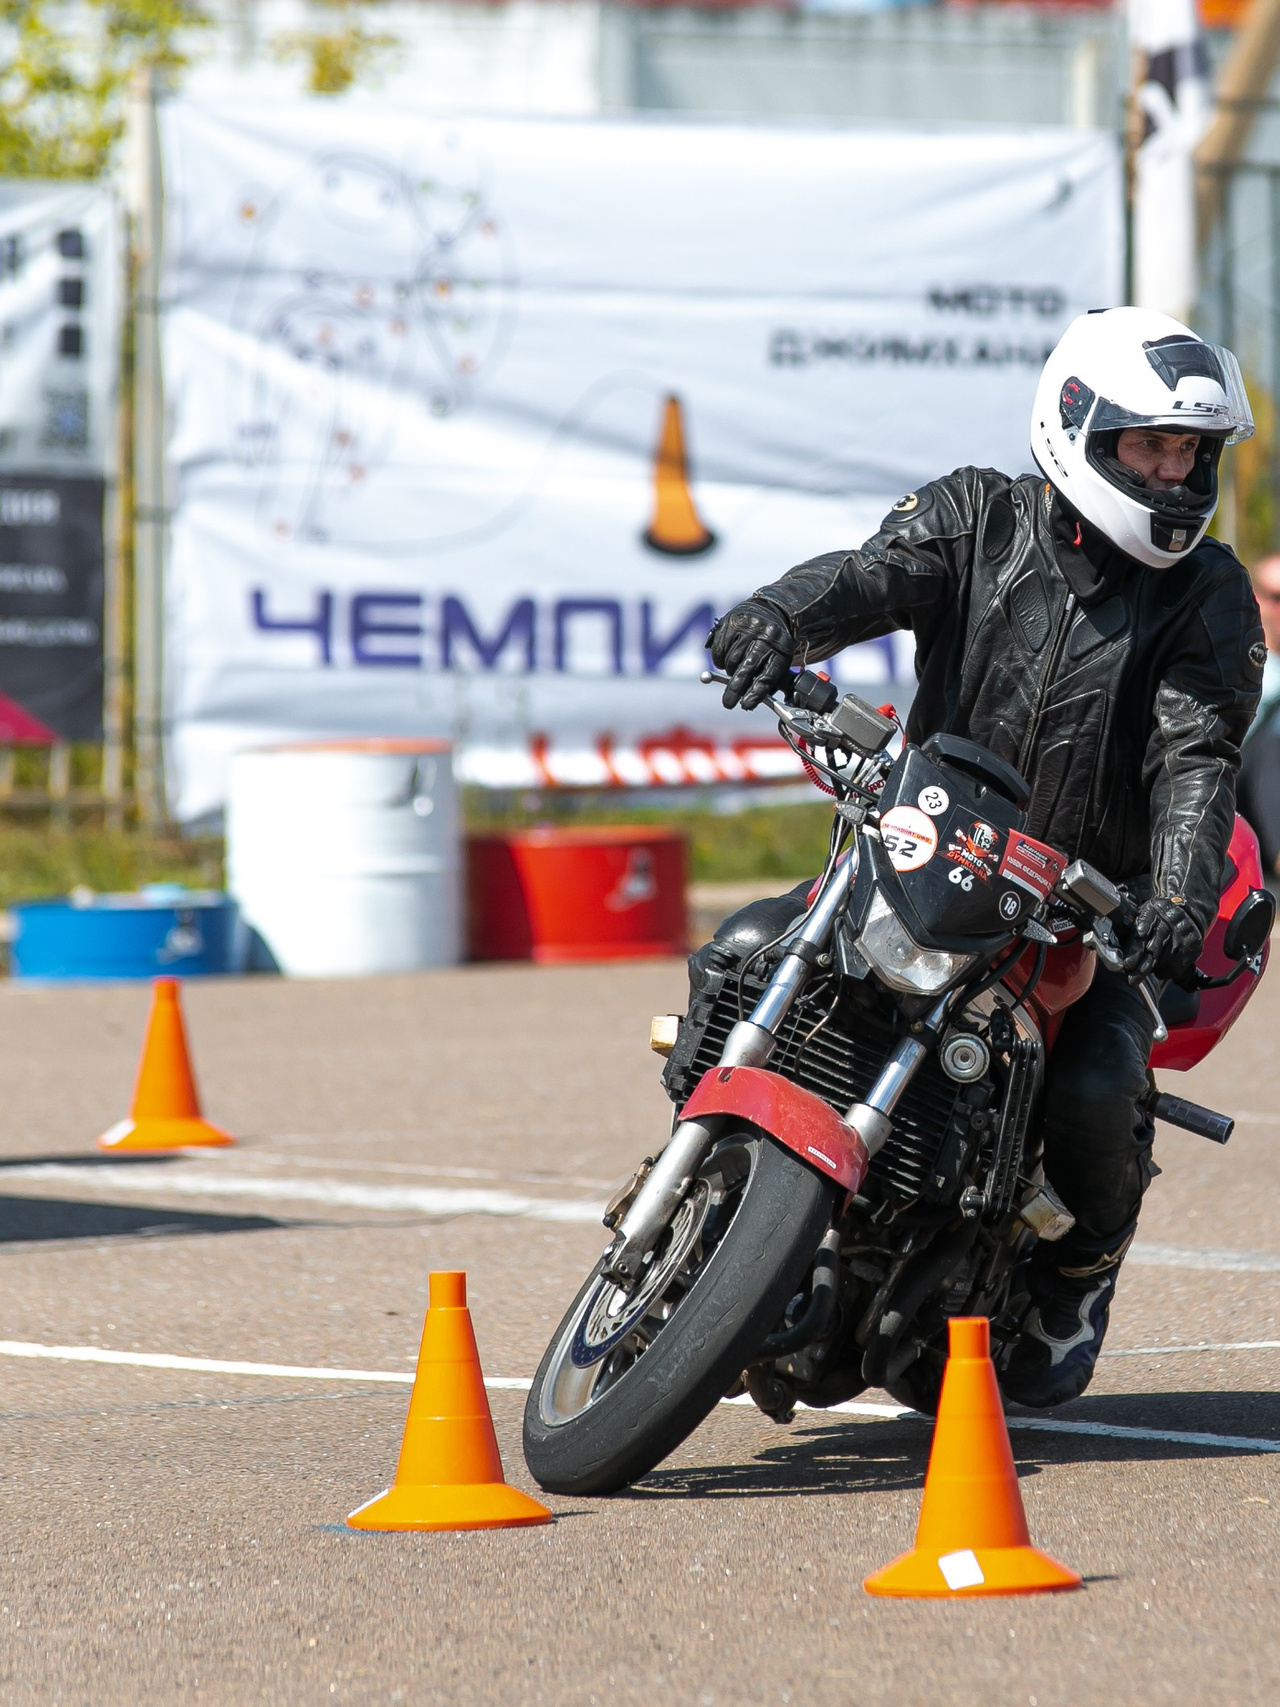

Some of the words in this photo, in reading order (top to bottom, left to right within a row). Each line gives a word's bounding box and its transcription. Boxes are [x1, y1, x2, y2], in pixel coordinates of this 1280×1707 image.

[928, 284, 1067, 318] МОТО
[1172, 400, 1230, 414] LS2
[252, 588, 898, 680] ЧЕМПИ
[925, 791, 943, 810] 23
[884, 833, 918, 858] 52
[960, 848, 984, 868] MOTO
[947, 866, 976, 892] 66
[1003, 896, 1018, 916] 18
